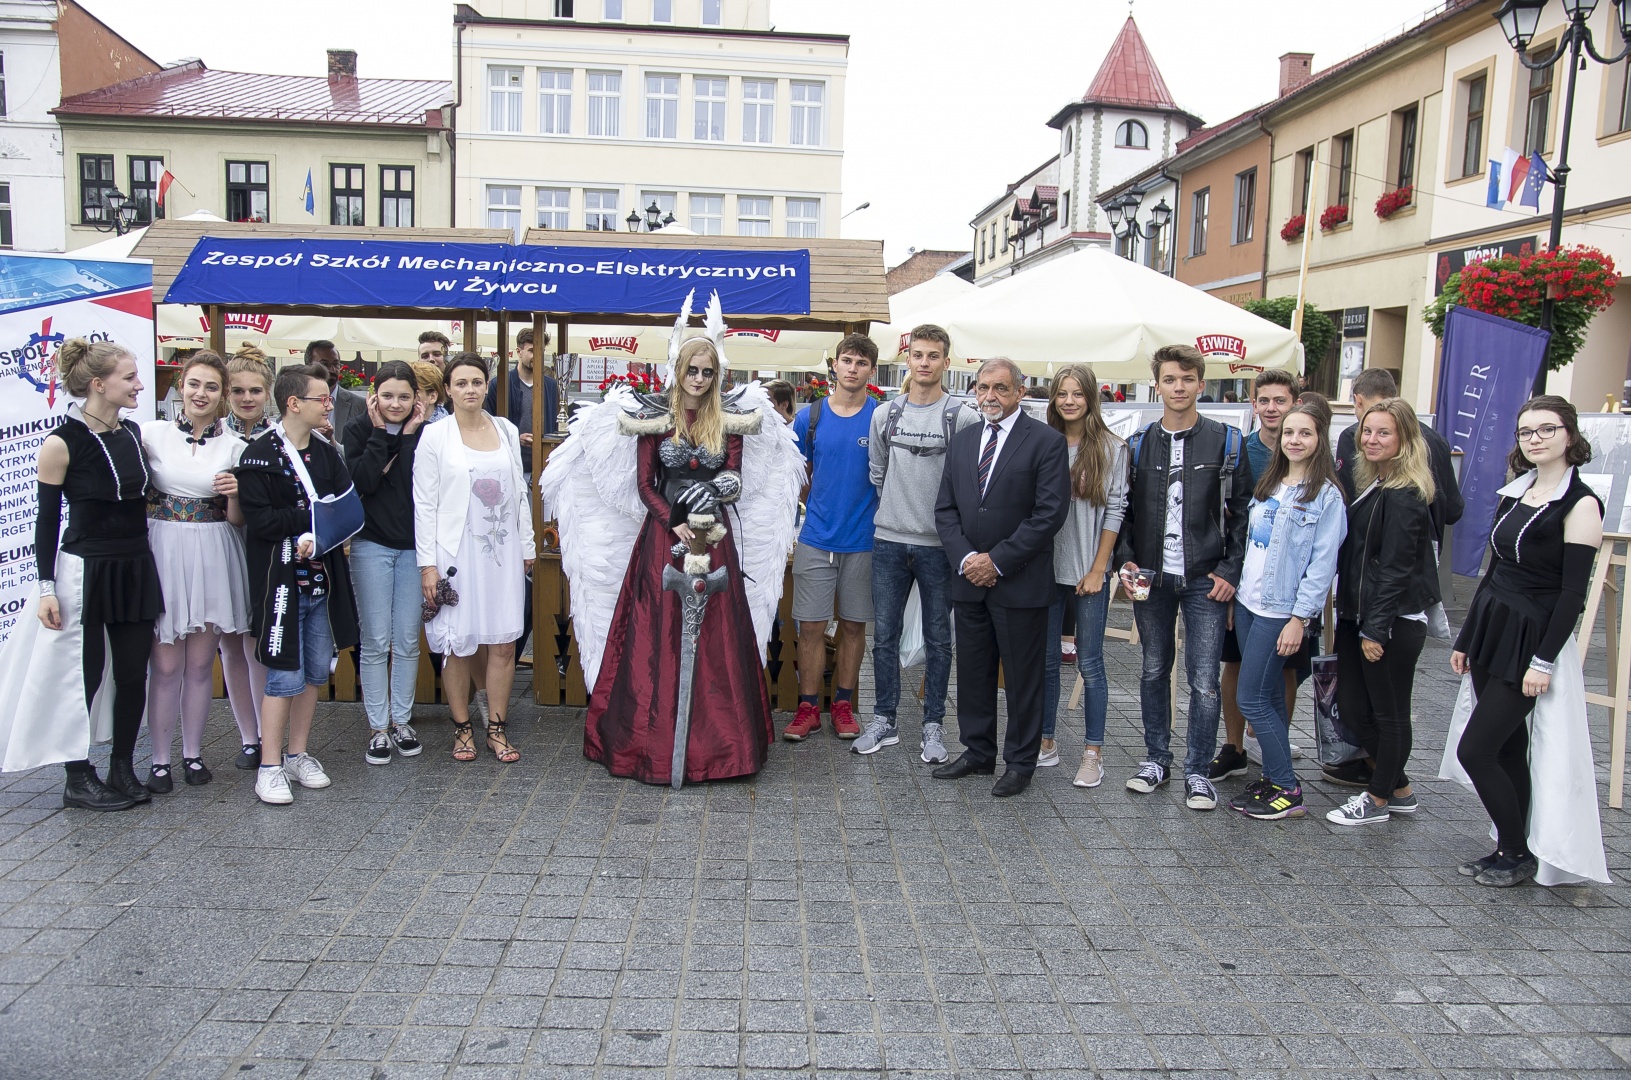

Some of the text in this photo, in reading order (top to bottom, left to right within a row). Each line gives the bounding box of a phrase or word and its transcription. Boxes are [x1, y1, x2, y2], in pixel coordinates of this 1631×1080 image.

[201, 251, 797, 281] Zespół Szkół Mechaniczno-Elektrycznych
[433, 276, 558, 296] w Żywcu
[1201, 336, 1241, 352] ŻYWIEC
[892, 427, 945, 442] Champion
